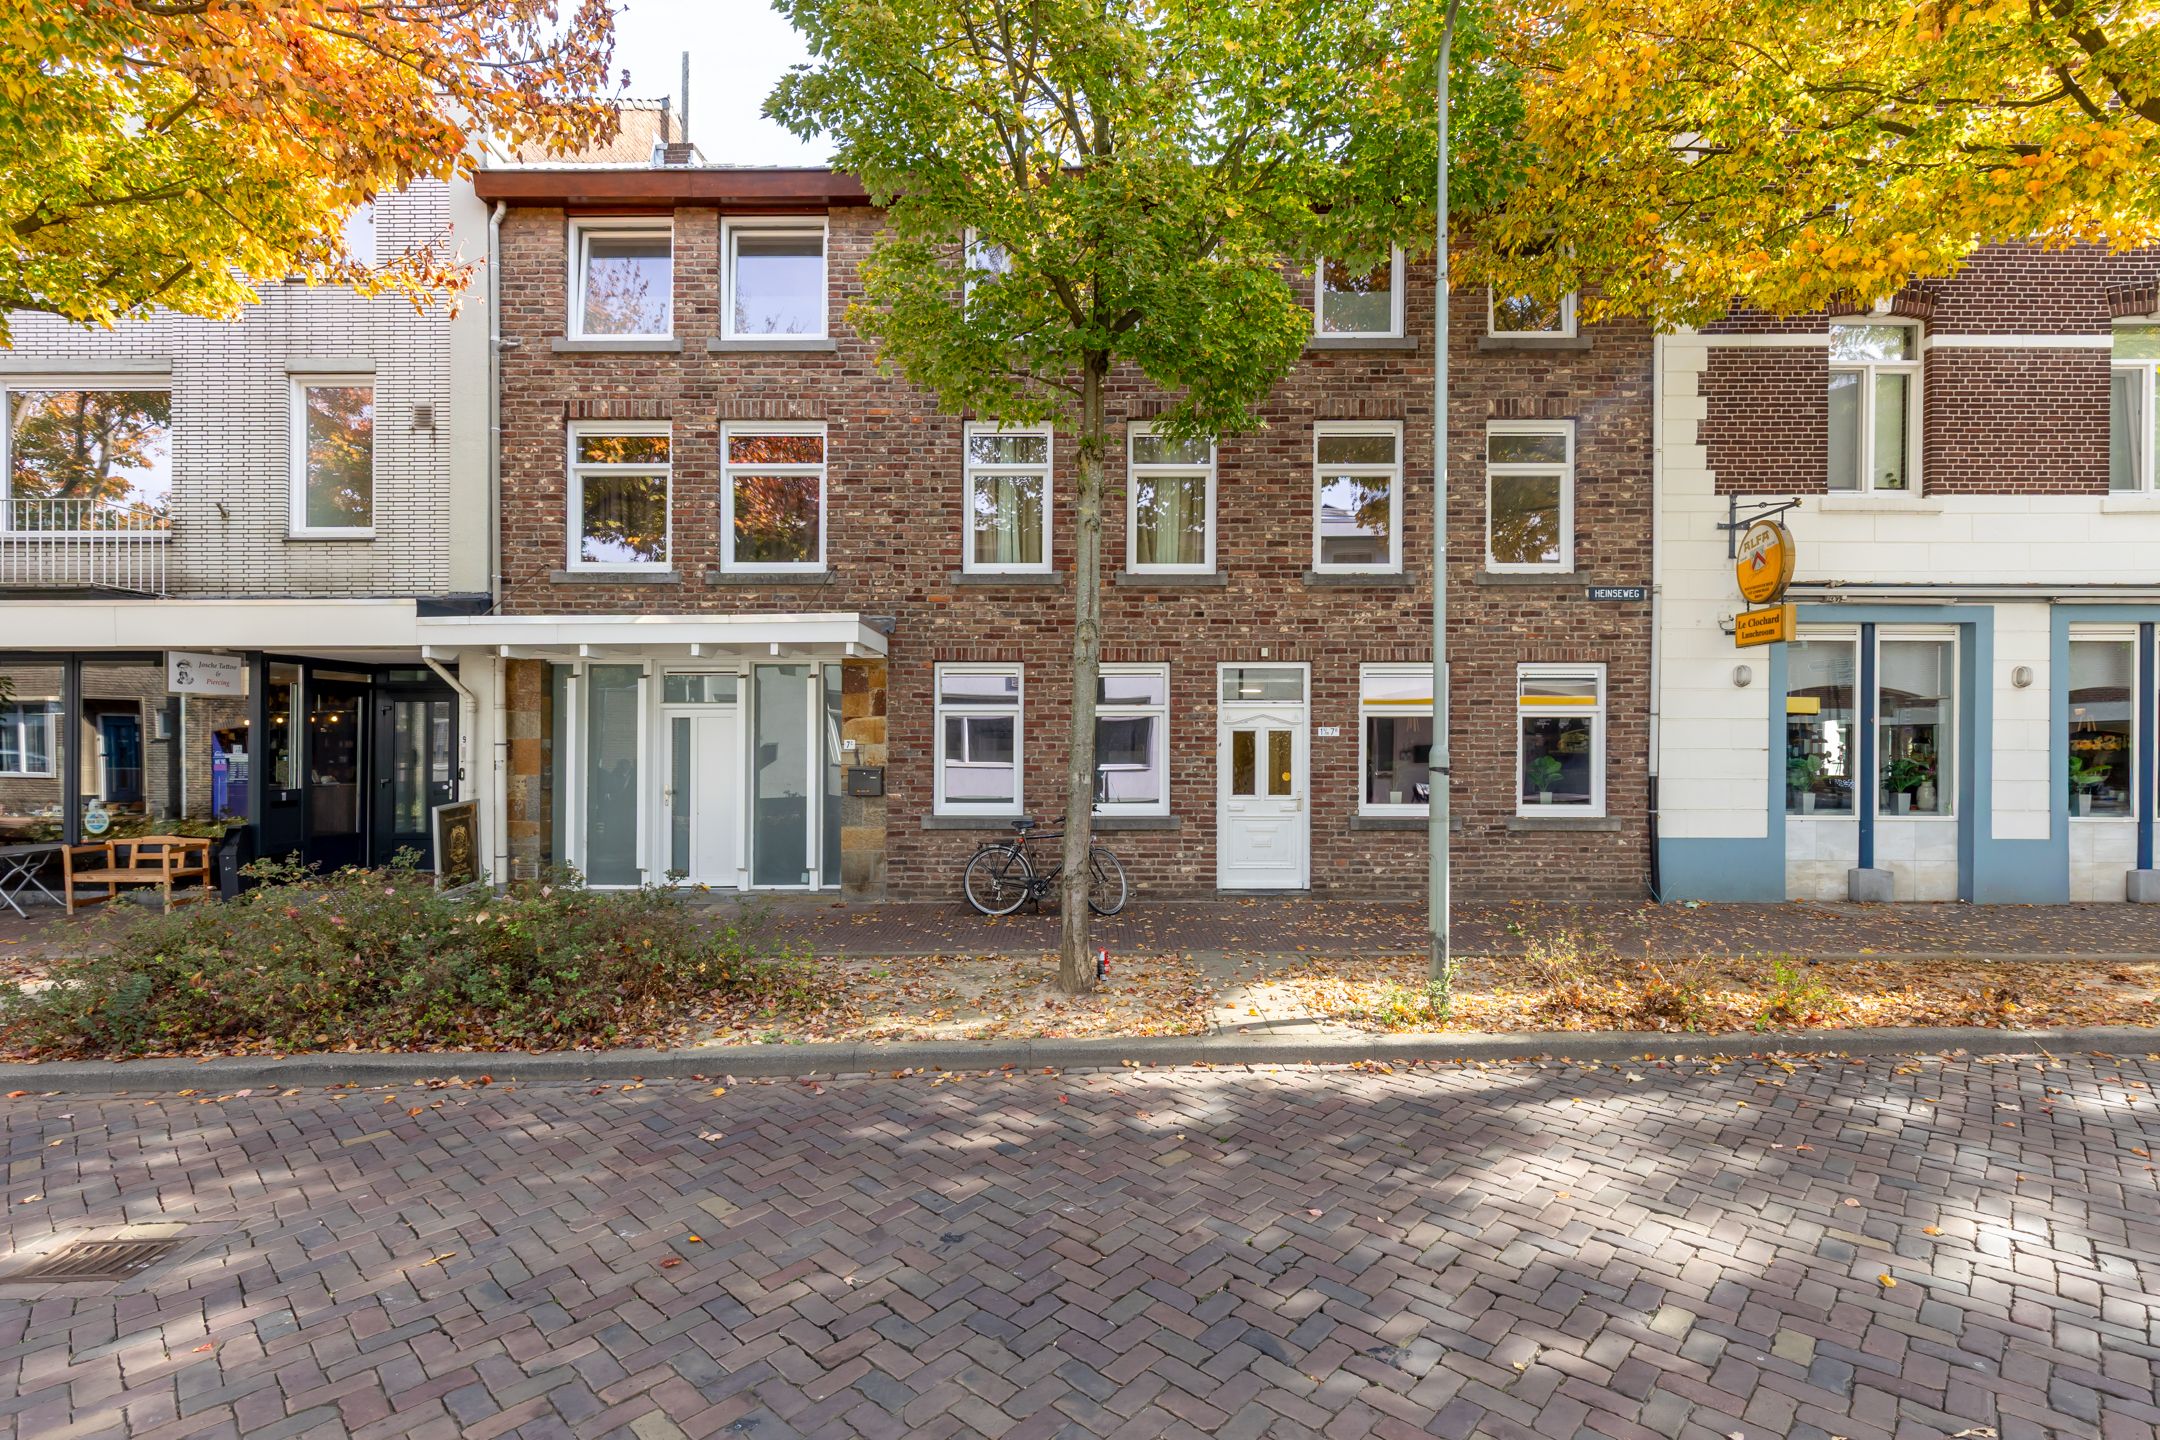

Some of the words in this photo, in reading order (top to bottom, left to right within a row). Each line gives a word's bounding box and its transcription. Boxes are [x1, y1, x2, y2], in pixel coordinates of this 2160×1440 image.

[1743, 530, 1770, 553] ALFA
[1594, 589, 1640, 598] HEINSEWEG
[1738, 620, 1747, 630] Le
[1748, 615, 1779, 628] Clochard
[1742, 628, 1775, 639] Lunchroom
[218, 662, 237, 670] Tattoo
[206, 678, 230, 688] Piercing
